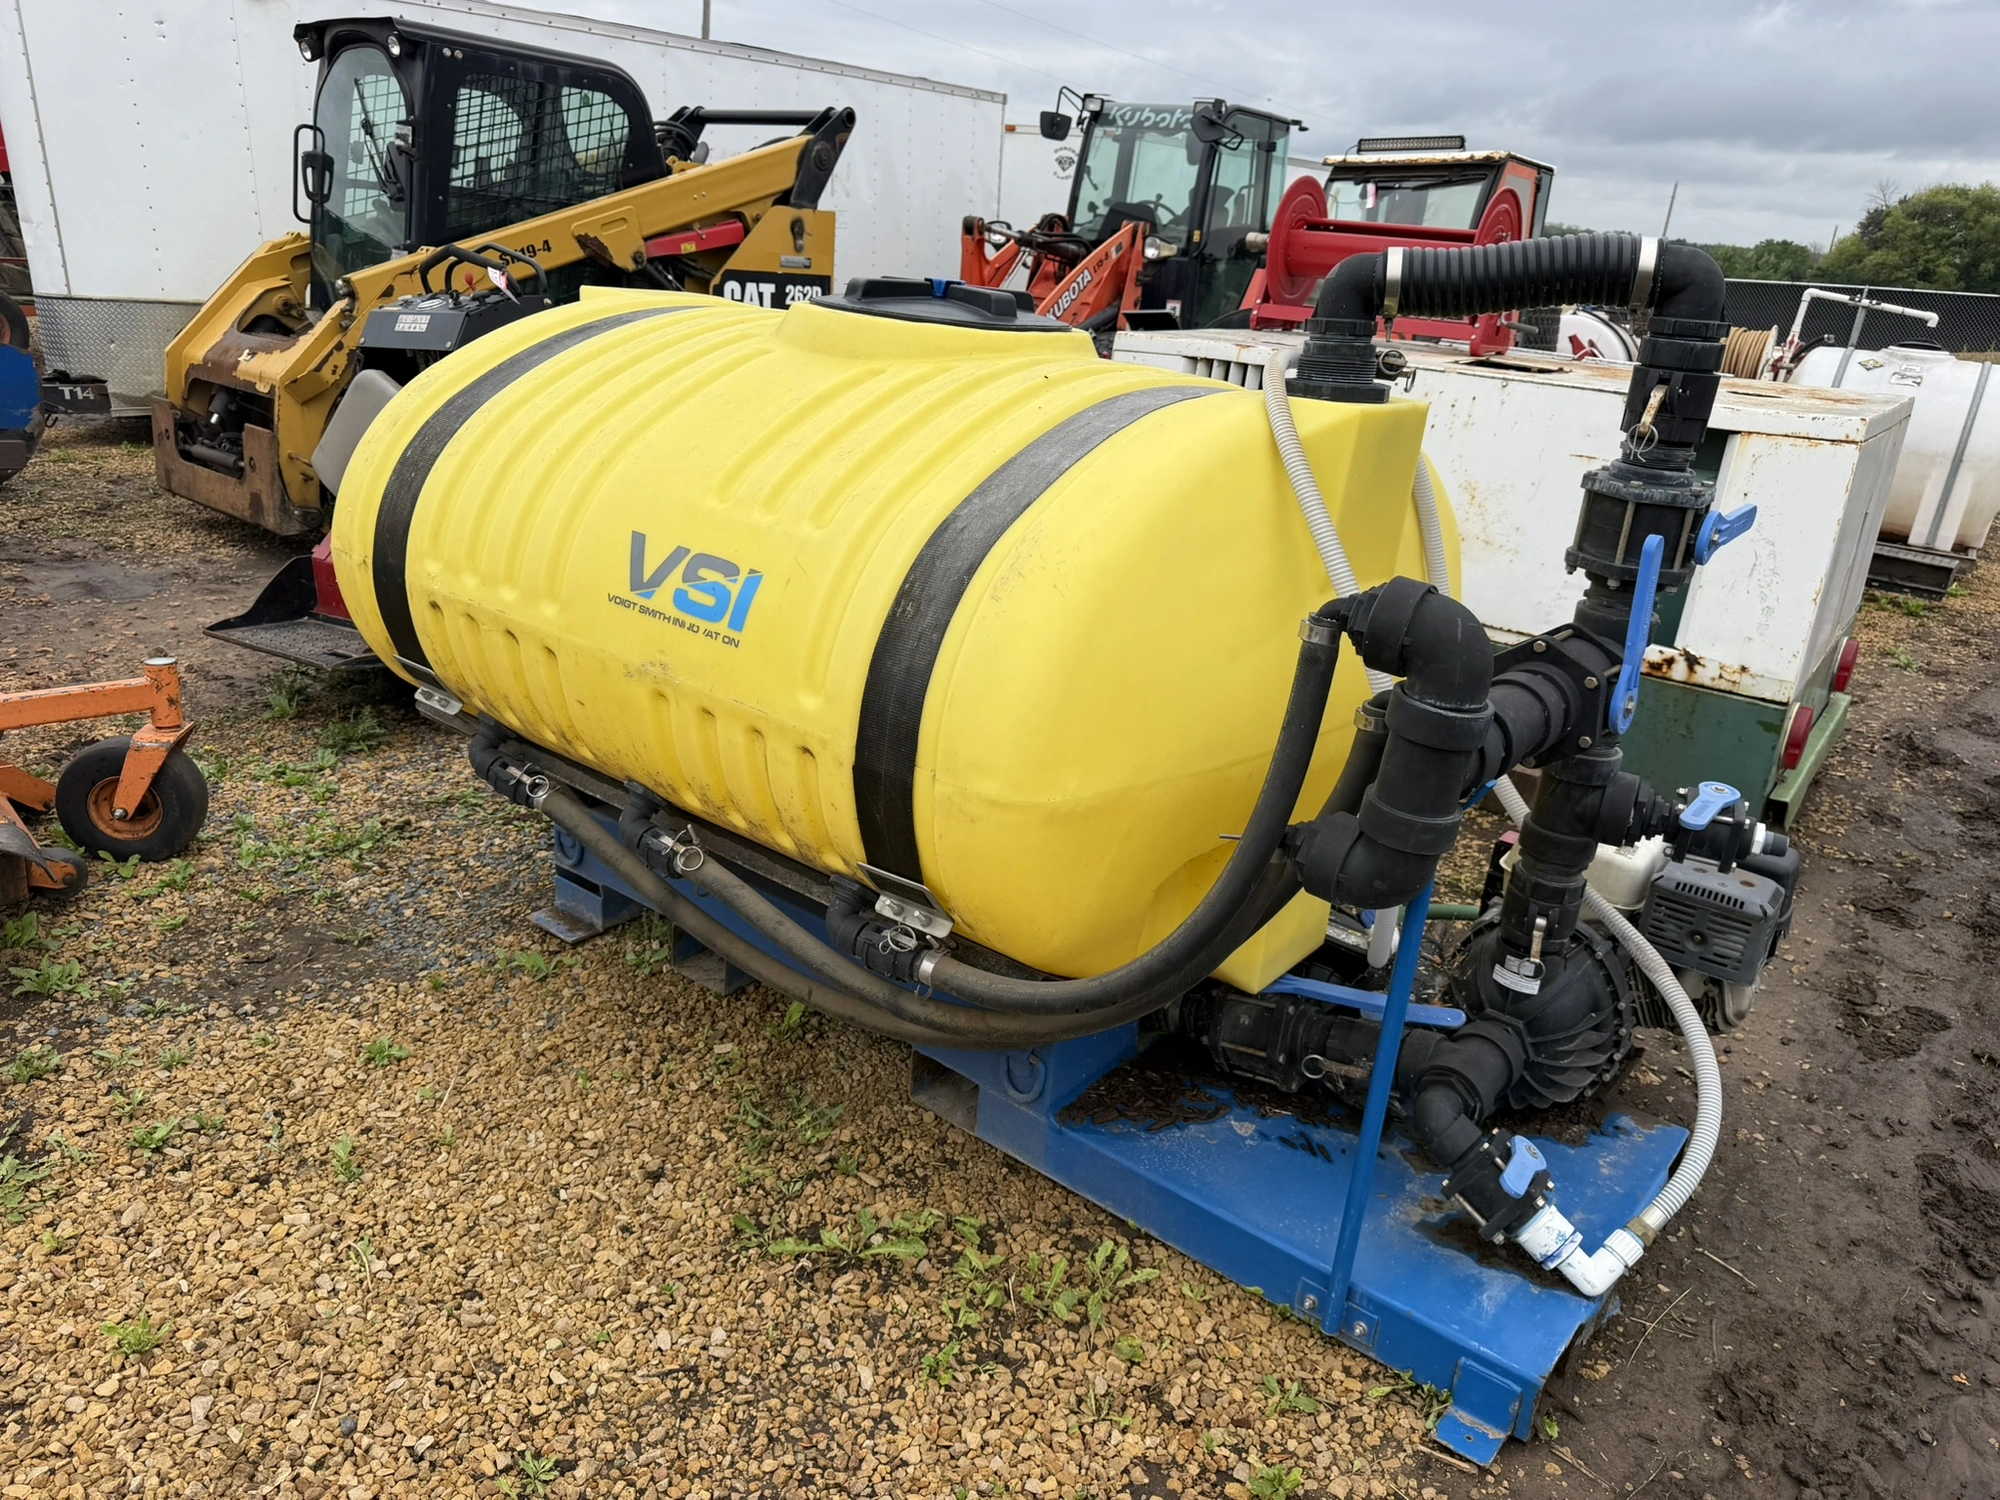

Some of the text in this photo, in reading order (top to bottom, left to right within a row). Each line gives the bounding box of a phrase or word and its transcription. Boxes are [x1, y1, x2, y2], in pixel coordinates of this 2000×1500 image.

[1109, 106, 1194, 129] Kubota
[723, 280, 822, 309] CAT 262D
[1046, 267, 1093, 321] KUBOTA
[58, 386, 95, 400] T14
[630, 530, 764, 633] VSI
[607, 593, 741, 649] VOIGT SMITH INNOATON
